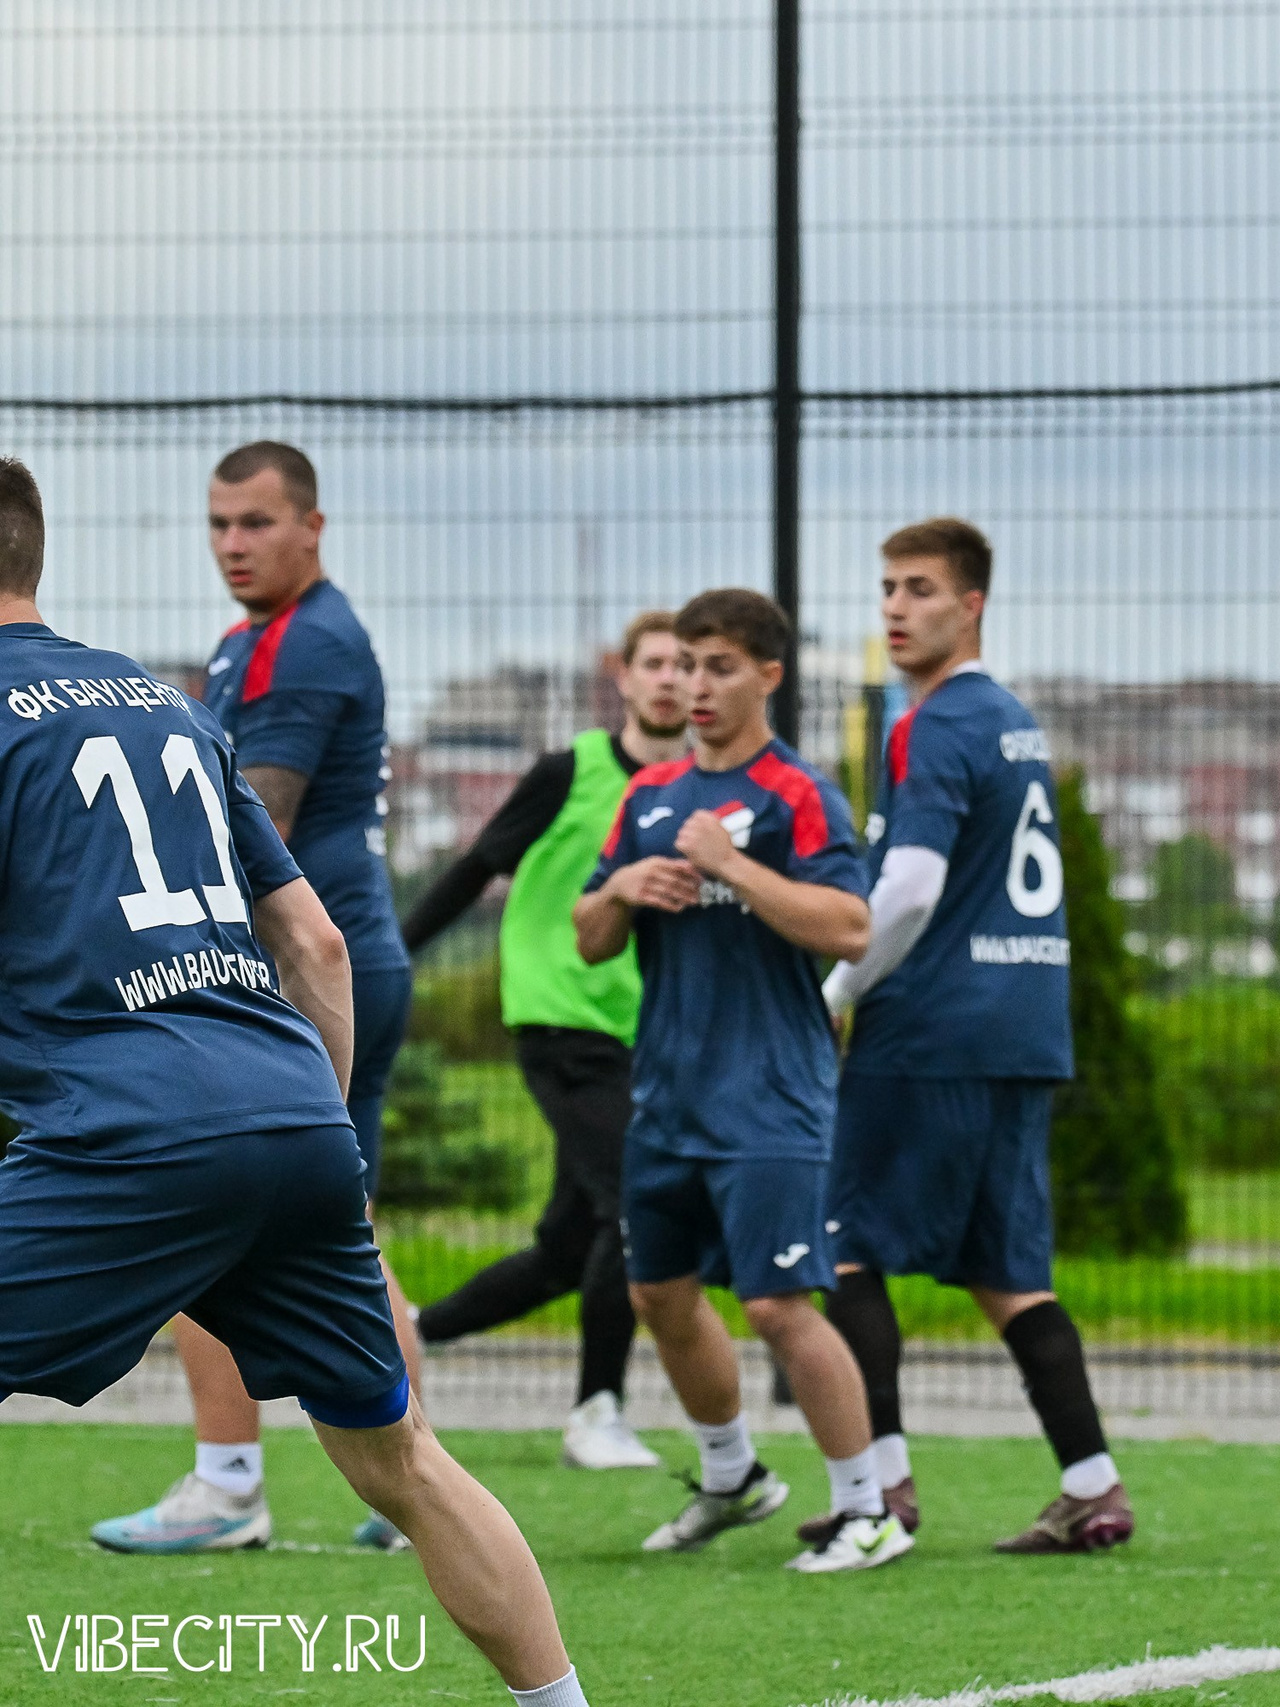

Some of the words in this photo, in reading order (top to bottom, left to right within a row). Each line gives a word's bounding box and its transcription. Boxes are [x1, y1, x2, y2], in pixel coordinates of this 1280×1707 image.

[7, 680, 70, 721] ФК
[71, 733, 252, 935] 11
[1006, 780, 1064, 918] 6
